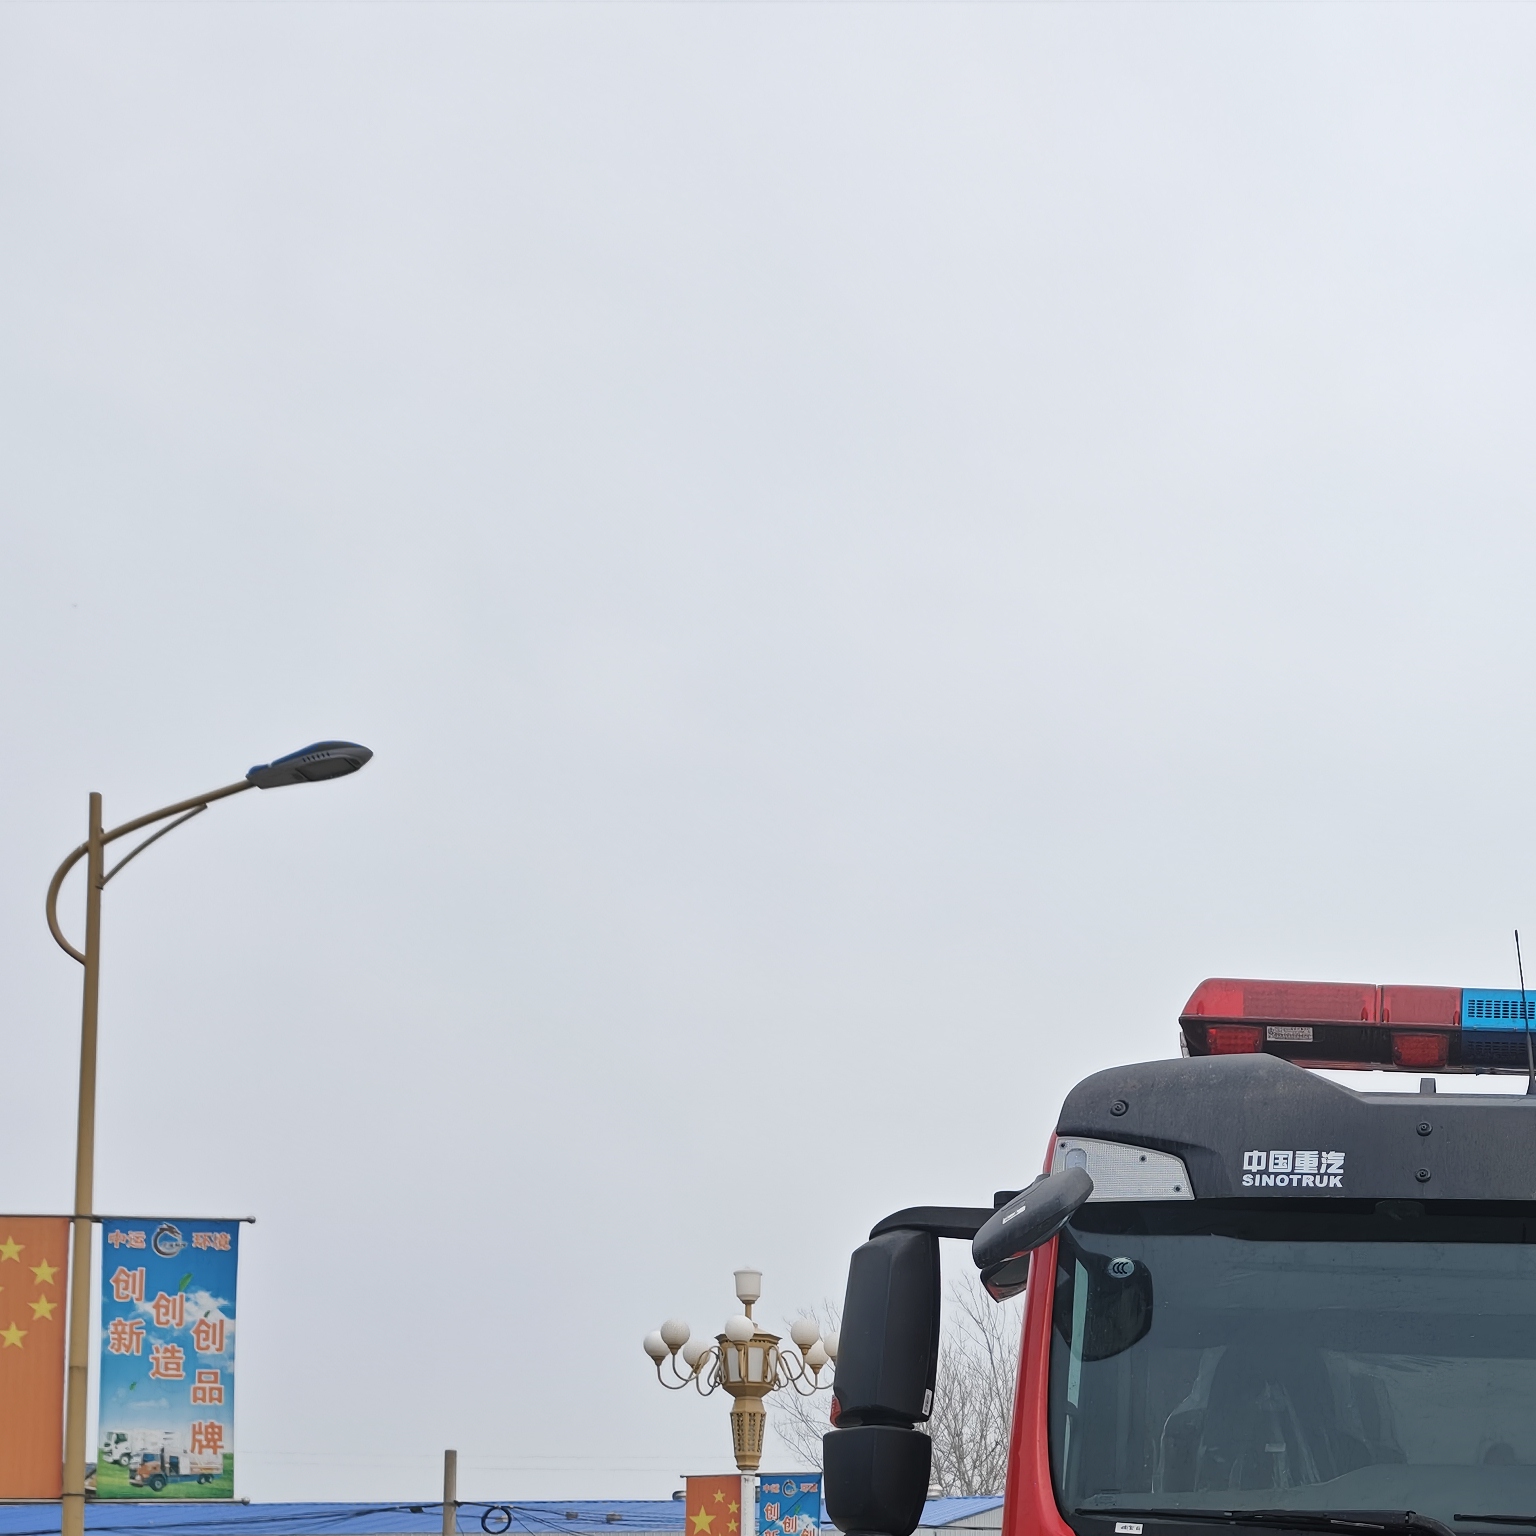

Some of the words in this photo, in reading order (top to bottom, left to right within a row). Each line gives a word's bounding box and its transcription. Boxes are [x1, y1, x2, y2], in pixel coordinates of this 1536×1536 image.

[1242, 1174, 1343, 1187] SINOTRUK
[1243, 1150, 1345, 1173] 中国重汽
[109, 1266, 145, 1355] 创新
[150, 1291, 185, 1380] 创造
[190, 1317, 224, 1455] 创品牌
